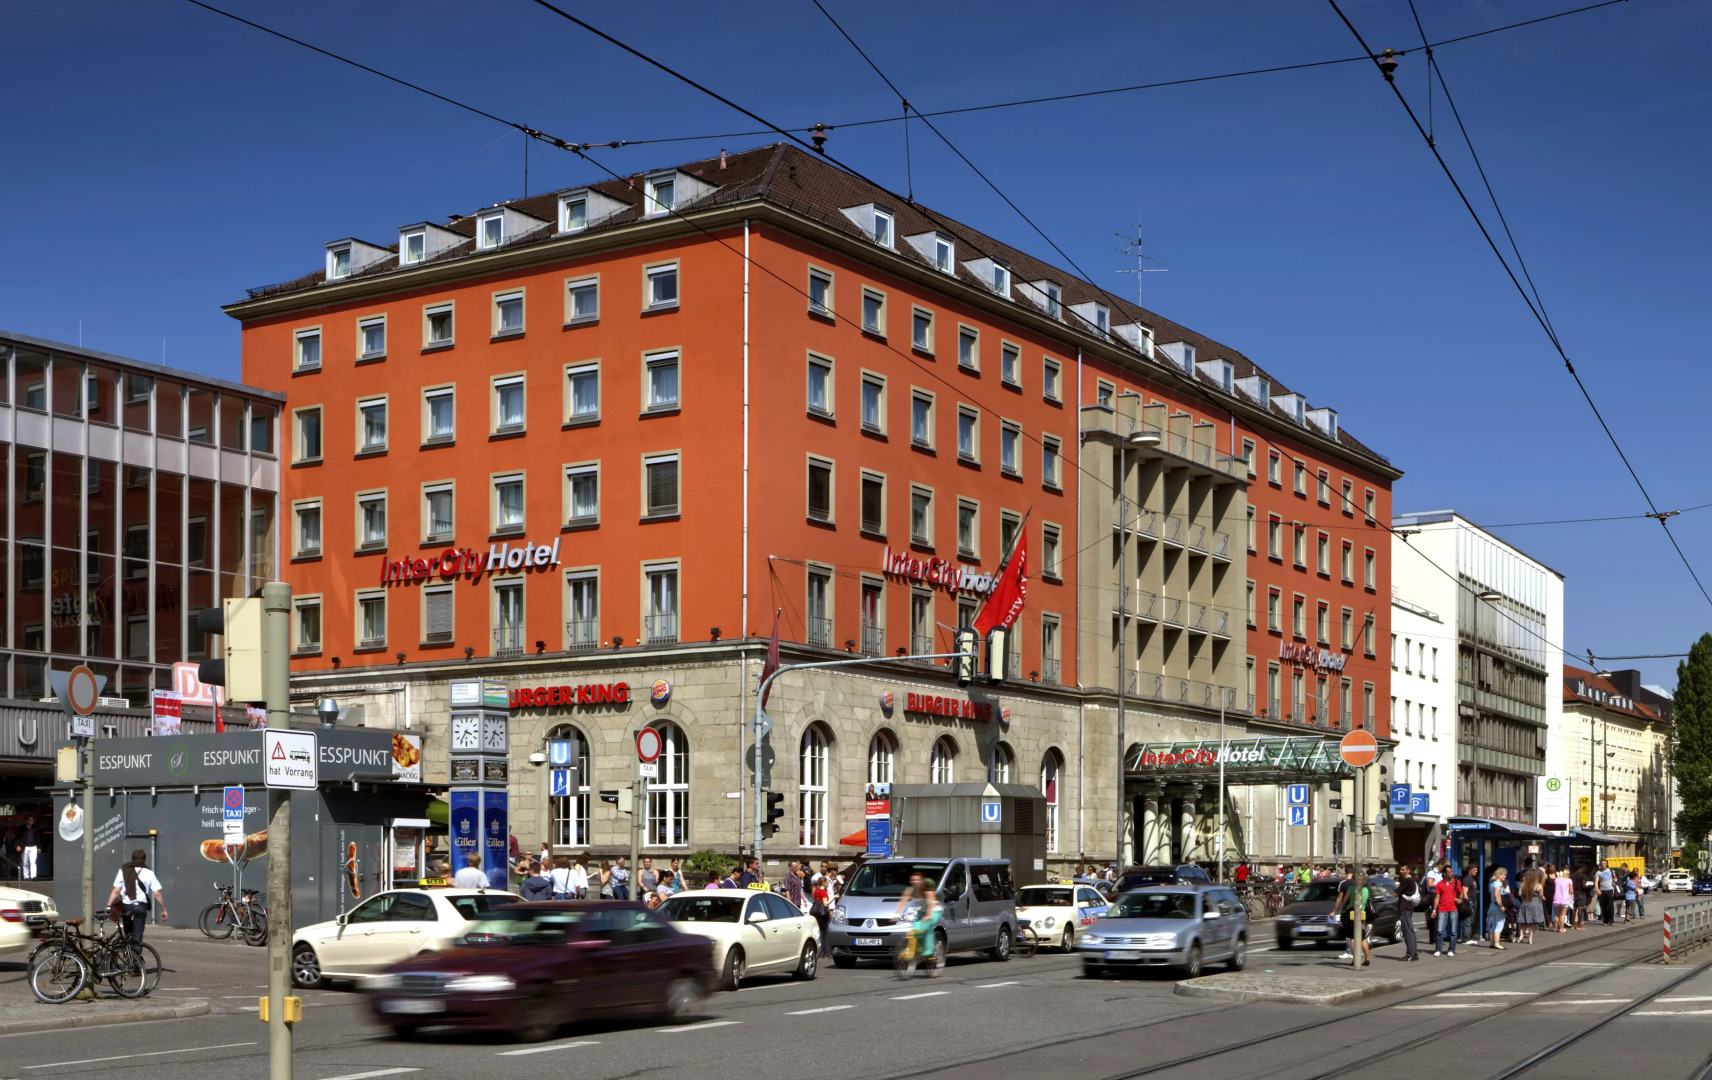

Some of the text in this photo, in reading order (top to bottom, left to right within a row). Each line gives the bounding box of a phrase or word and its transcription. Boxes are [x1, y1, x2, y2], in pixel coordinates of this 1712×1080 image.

[380, 537, 561, 581] InterCityHotel
[883, 546, 1002, 593] InterCityHote
[52, 612, 92, 629] KLASSK
[1280, 640, 1345, 671] InterCityHotel
[509, 682, 628, 708] URGER KING
[906, 692, 992, 720] BURGER KING
[77, 717, 91, 727] TAXI
[100, 754, 152, 770] ESSPUNKT
[203, 749, 260, 766] ESSPUNKT
[319, 746, 389, 766] ESSPUNKT
[553, 743, 567, 764] U
[1141, 746, 1266, 766] InterCityHotel
[269, 766, 313, 779] hat Vorrang
[1291, 787, 1304, 802] U
[1398, 791, 1405, 801] P
[985, 805, 998, 820] U
[1413, 801, 1419, 810] P
[454, 837, 476, 846] Eilles
[486, 838, 504, 847] Eilles
